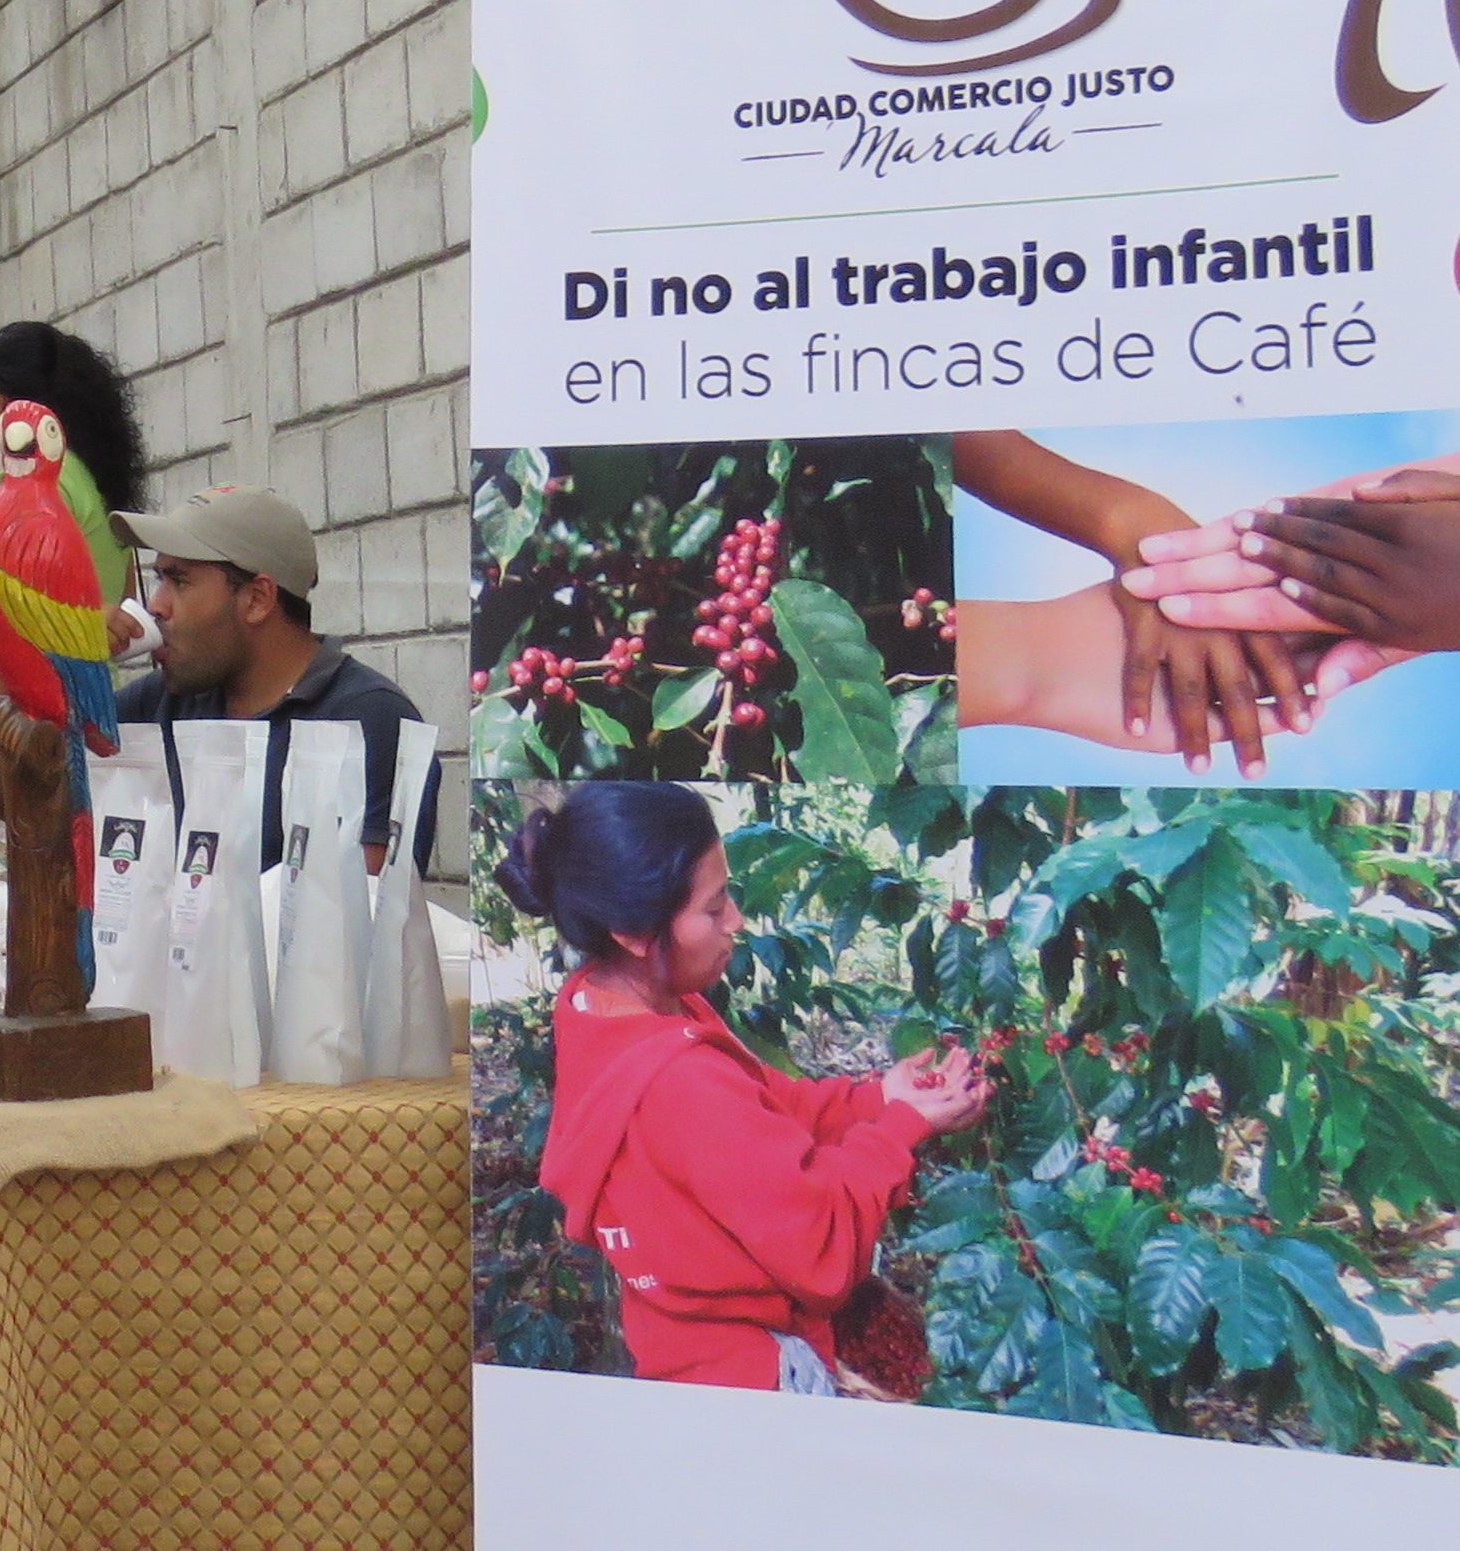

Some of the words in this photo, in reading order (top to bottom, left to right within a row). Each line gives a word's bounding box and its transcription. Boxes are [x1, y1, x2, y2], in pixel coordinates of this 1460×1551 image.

[734, 93, 857, 129] CIUDAD
[869, 76, 1053, 116] COMERCIO
[1061, 65, 1175, 108] JUSTO
[839, 105, 1065, 179] Marcala
[565, 267, 628, 321] Di
[651, 273, 732, 317] no
[754, 256, 810, 311] al
[831, 241, 1087, 307] trabajo
[1111, 214, 1374, 290] infantil
[566, 357, 646, 404] en
[681, 340, 772, 400] las
[802, 332, 1024, 394] fincas
[1057, 317, 1154, 383] de
[1188, 300, 1376, 375] Café
